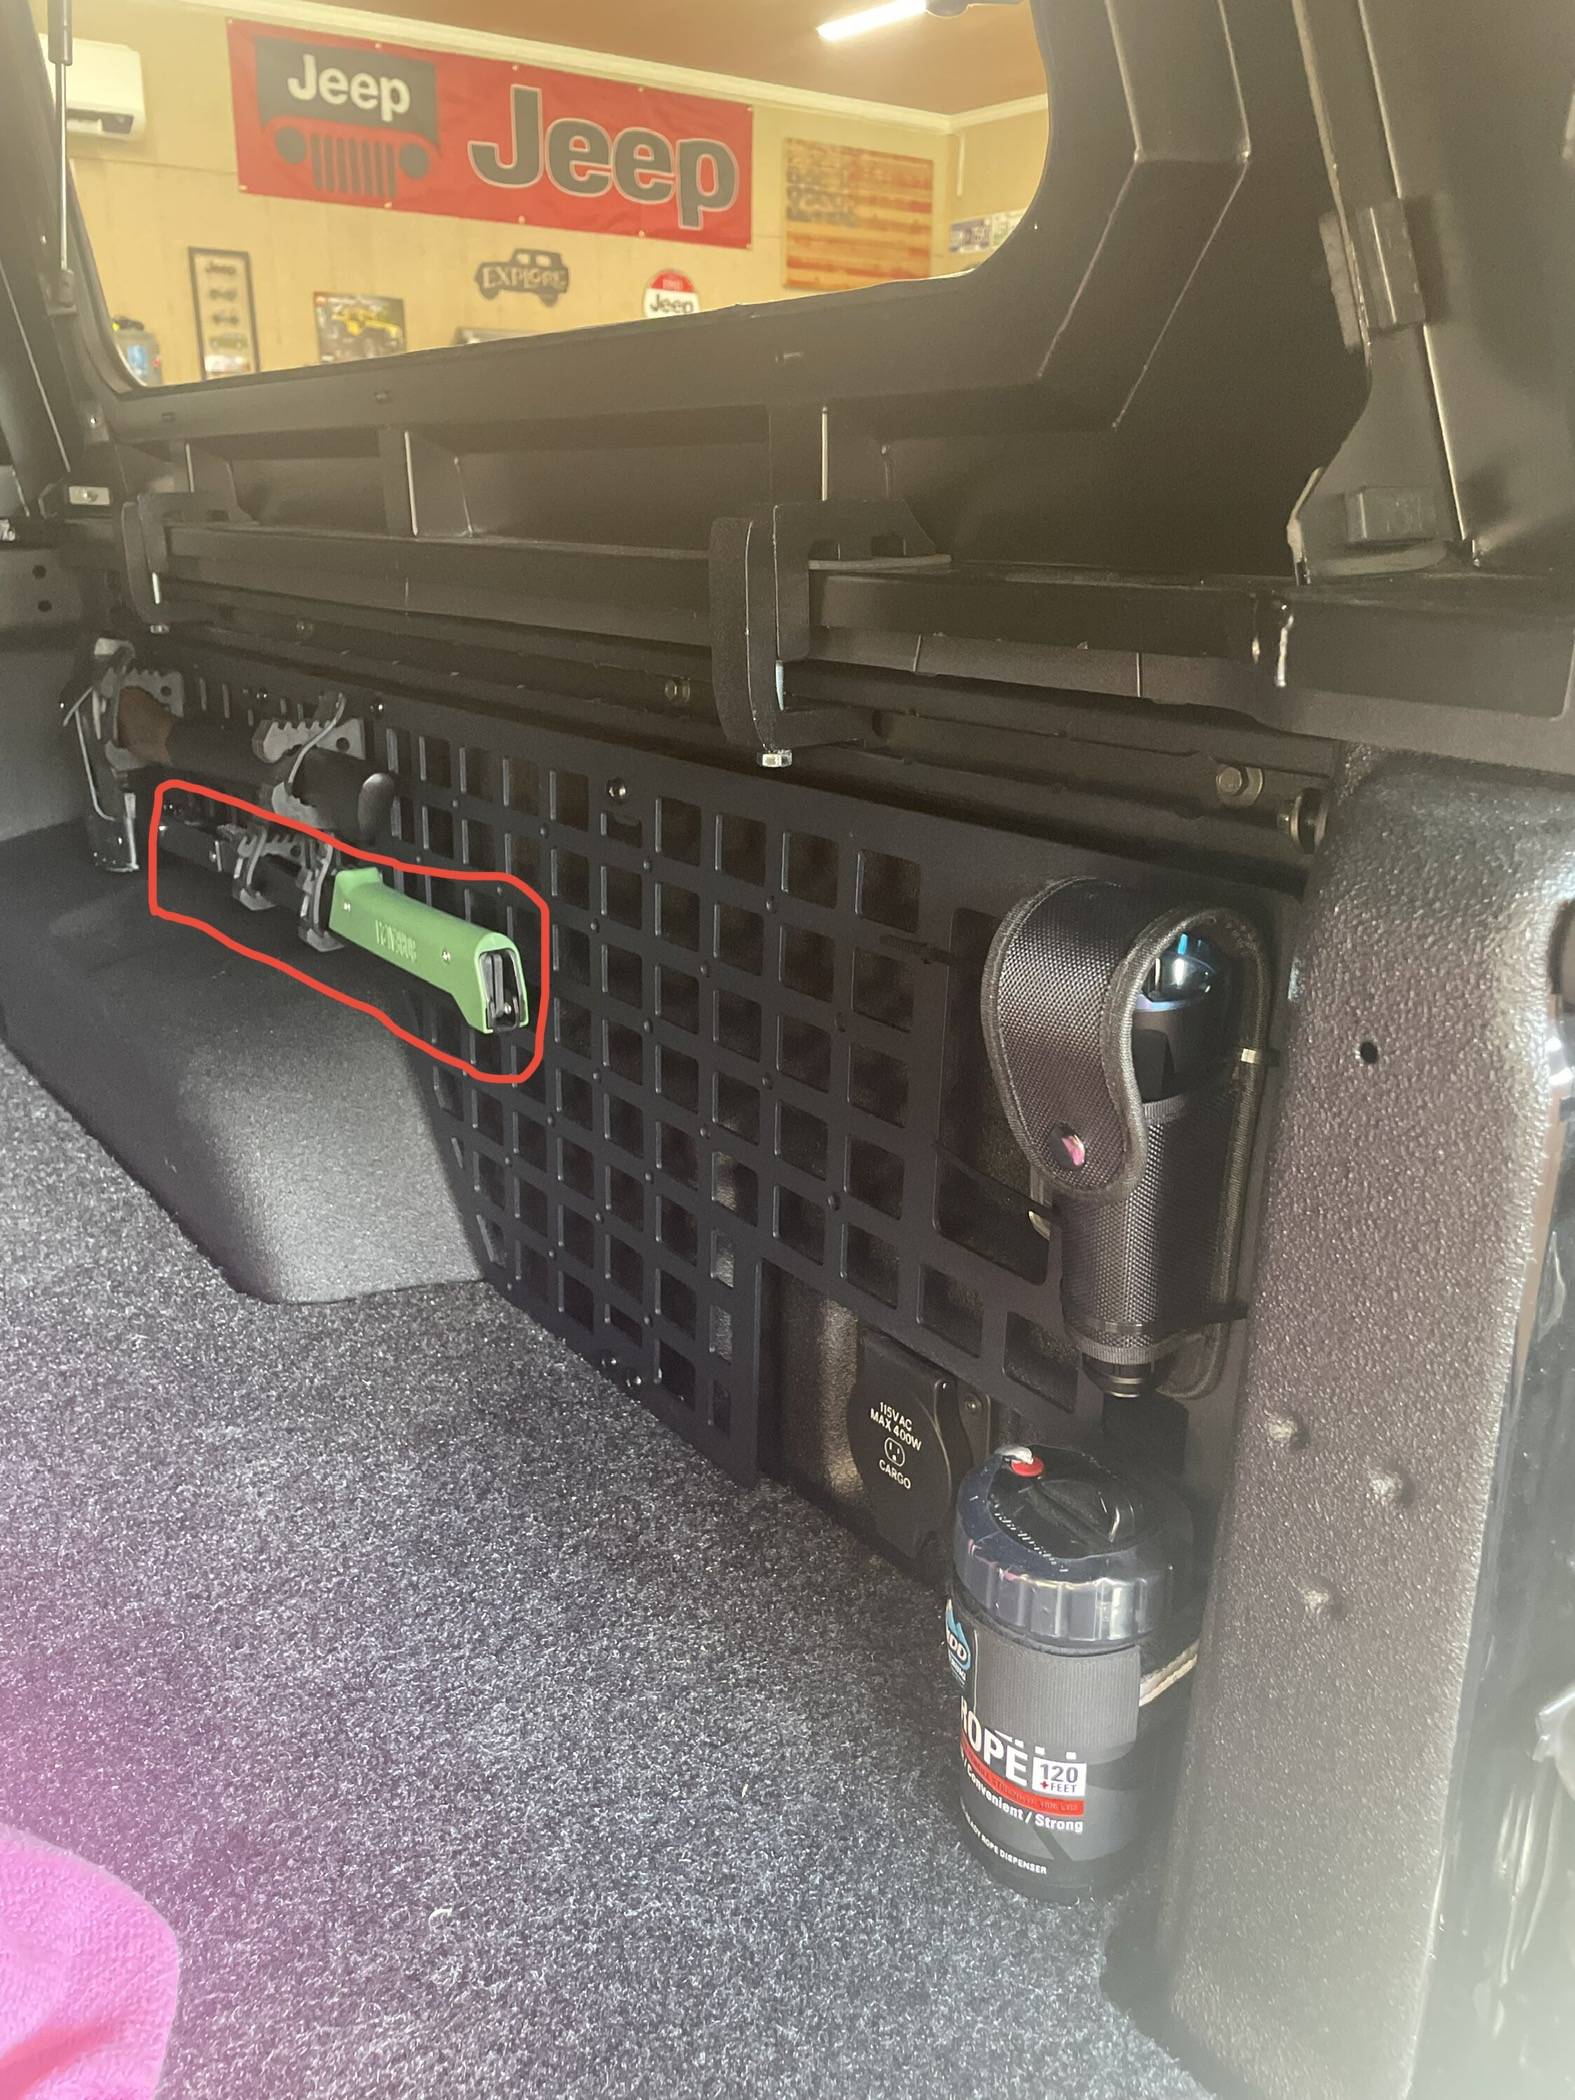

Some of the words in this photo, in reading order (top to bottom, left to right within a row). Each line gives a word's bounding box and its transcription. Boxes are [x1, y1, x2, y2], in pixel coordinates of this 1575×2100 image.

[287, 53, 411, 122] Jeep
[467, 84, 740, 231] Jeep
[482, 265, 567, 293] EXPLORE
[649, 293, 694, 314] Jeep
[870, 1408, 892, 1432] MAX
[893, 1423, 922, 1451] 400W
[878, 1459, 912, 1489] CARGO
[960, 1695, 1029, 1787] ROPE
[1040, 1763, 1079, 1784] 120
[1050, 1782, 1077, 1793] FEET
[967, 1763, 1024, 1821] Convenient
[1024, 1811, 1033, 1825] /
[1034, 1811, 1084, 1833] Strong
[981, 1834, 999, 1855] ROPE
[999, 1849, 1048, 1875] DISPENSER
